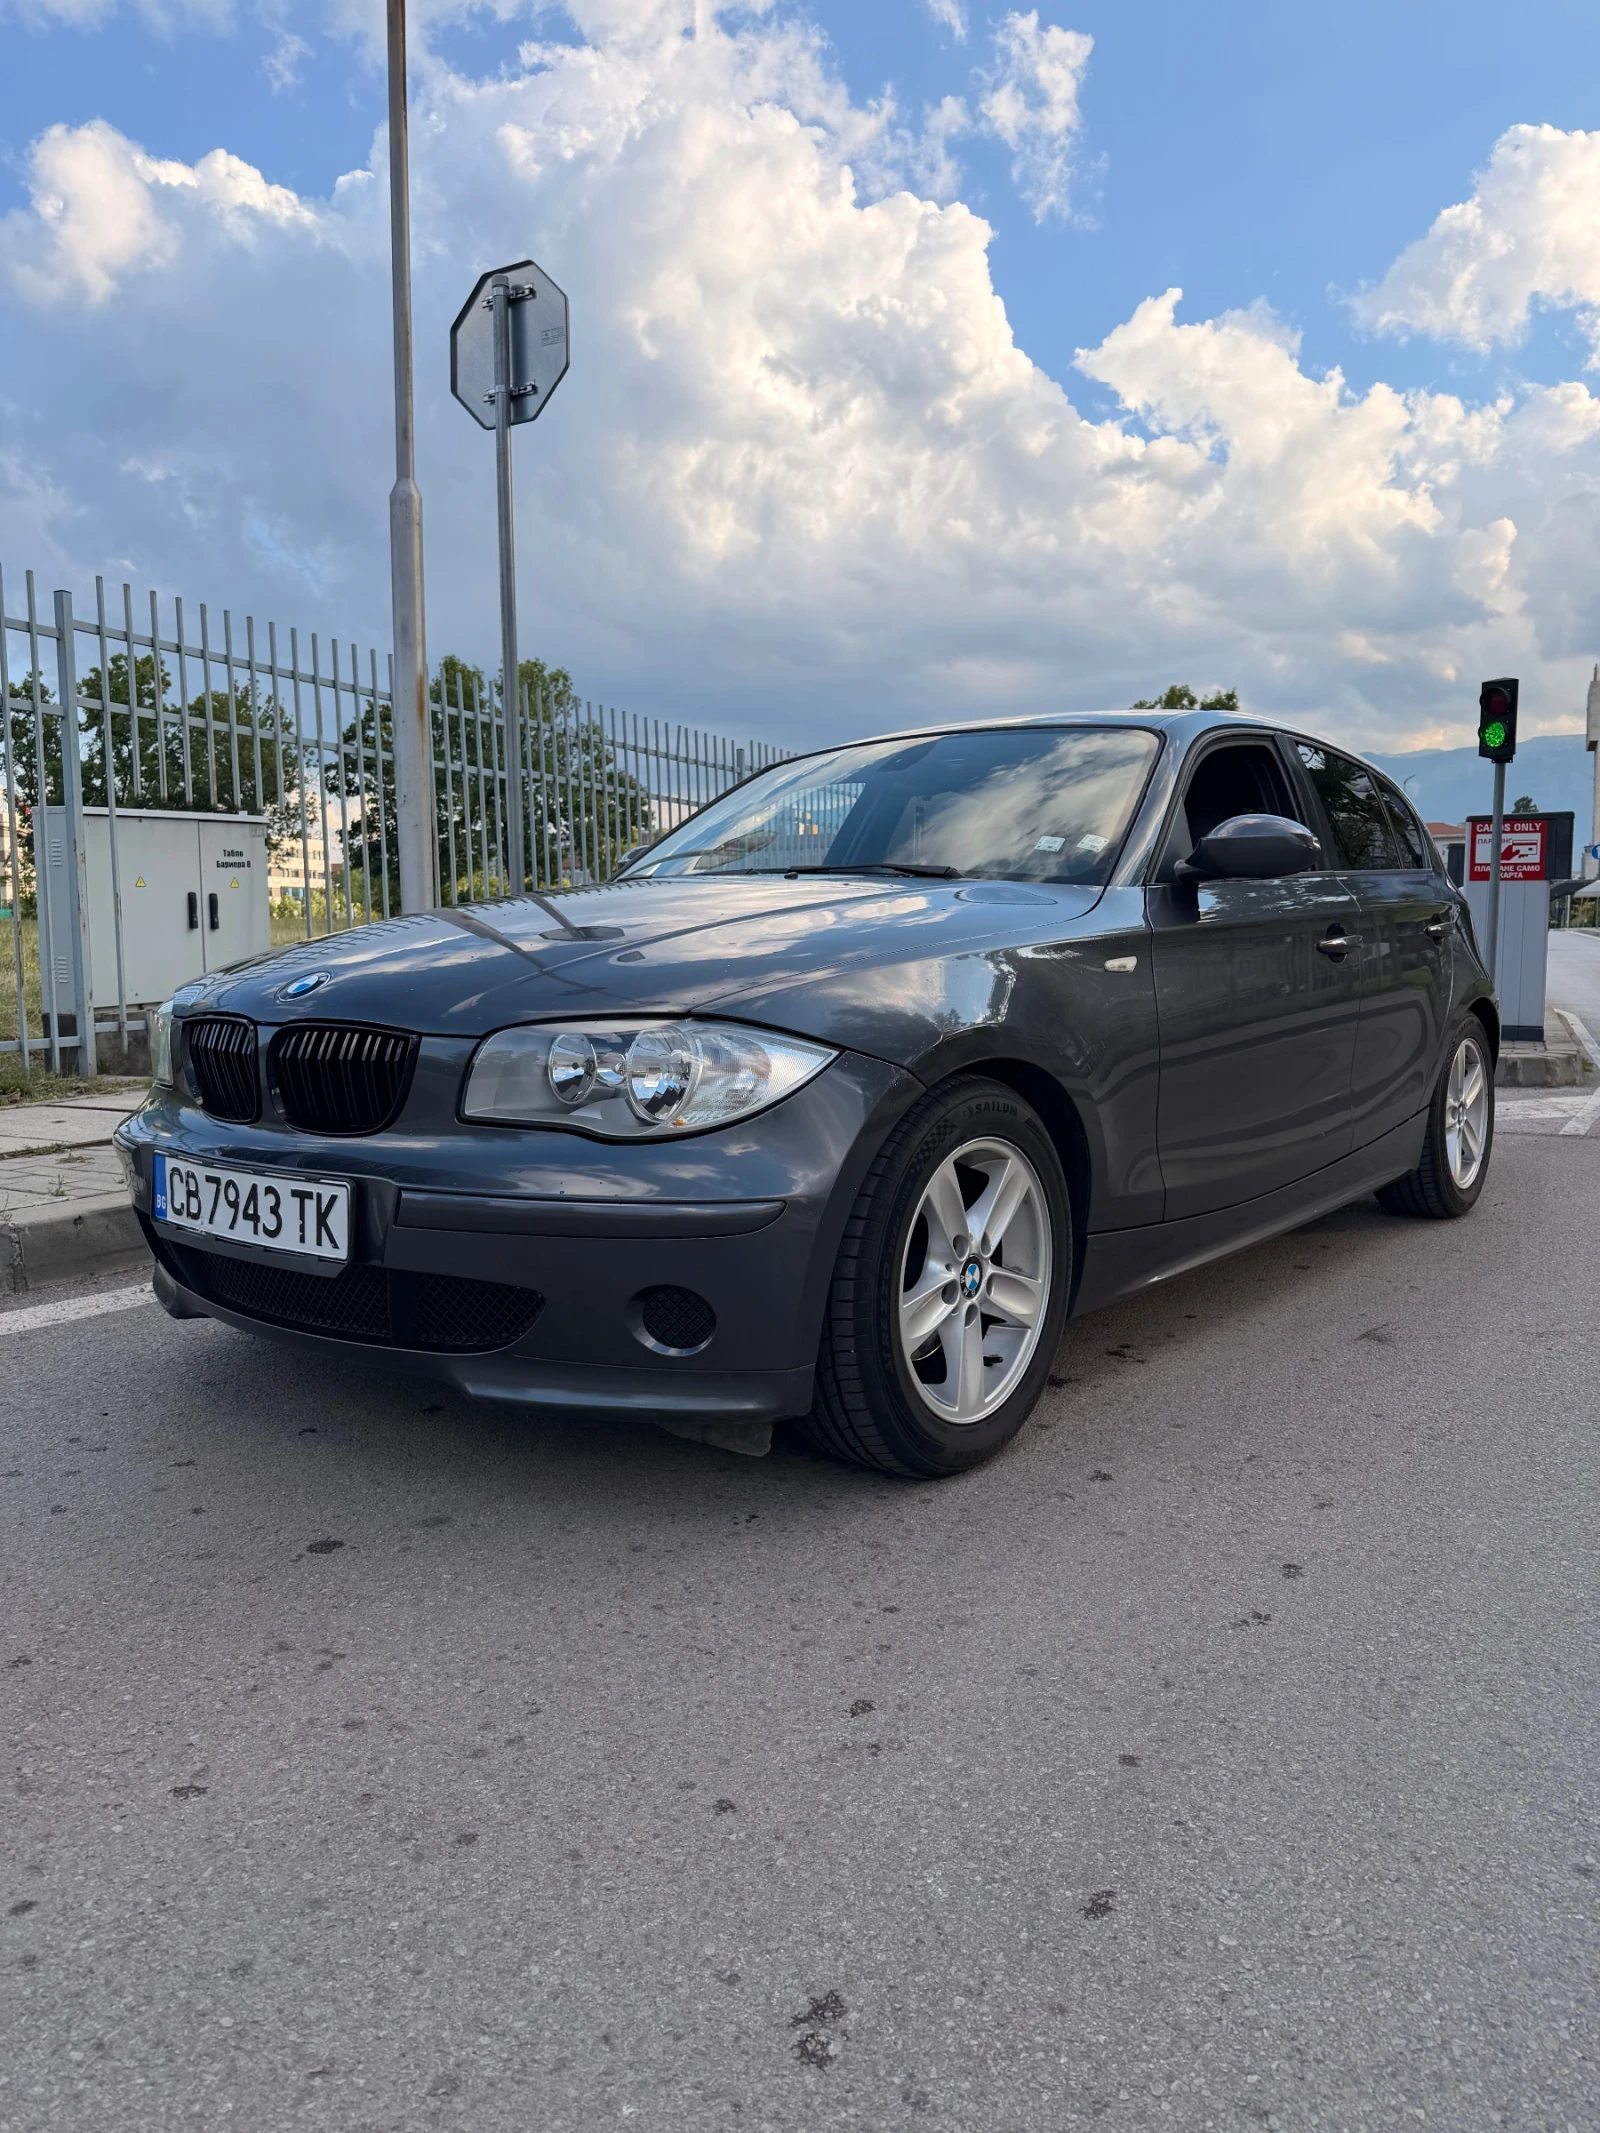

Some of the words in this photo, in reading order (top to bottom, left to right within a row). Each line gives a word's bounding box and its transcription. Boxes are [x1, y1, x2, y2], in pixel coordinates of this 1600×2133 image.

[1476, 823, 1511, 832] CAS
[1513, 822, 1542, 832] ONLY
[222, 849, 244, 858] Табло
[216, 860, 246, 869] Бариера
[1474, 864, 1515, 872] ПЛААНЕ
[1516, 864, 1541, 872] САМО
[975, 1101, 1018, 1117] SAILUN
[156, 1193, 167, 1210] BG
